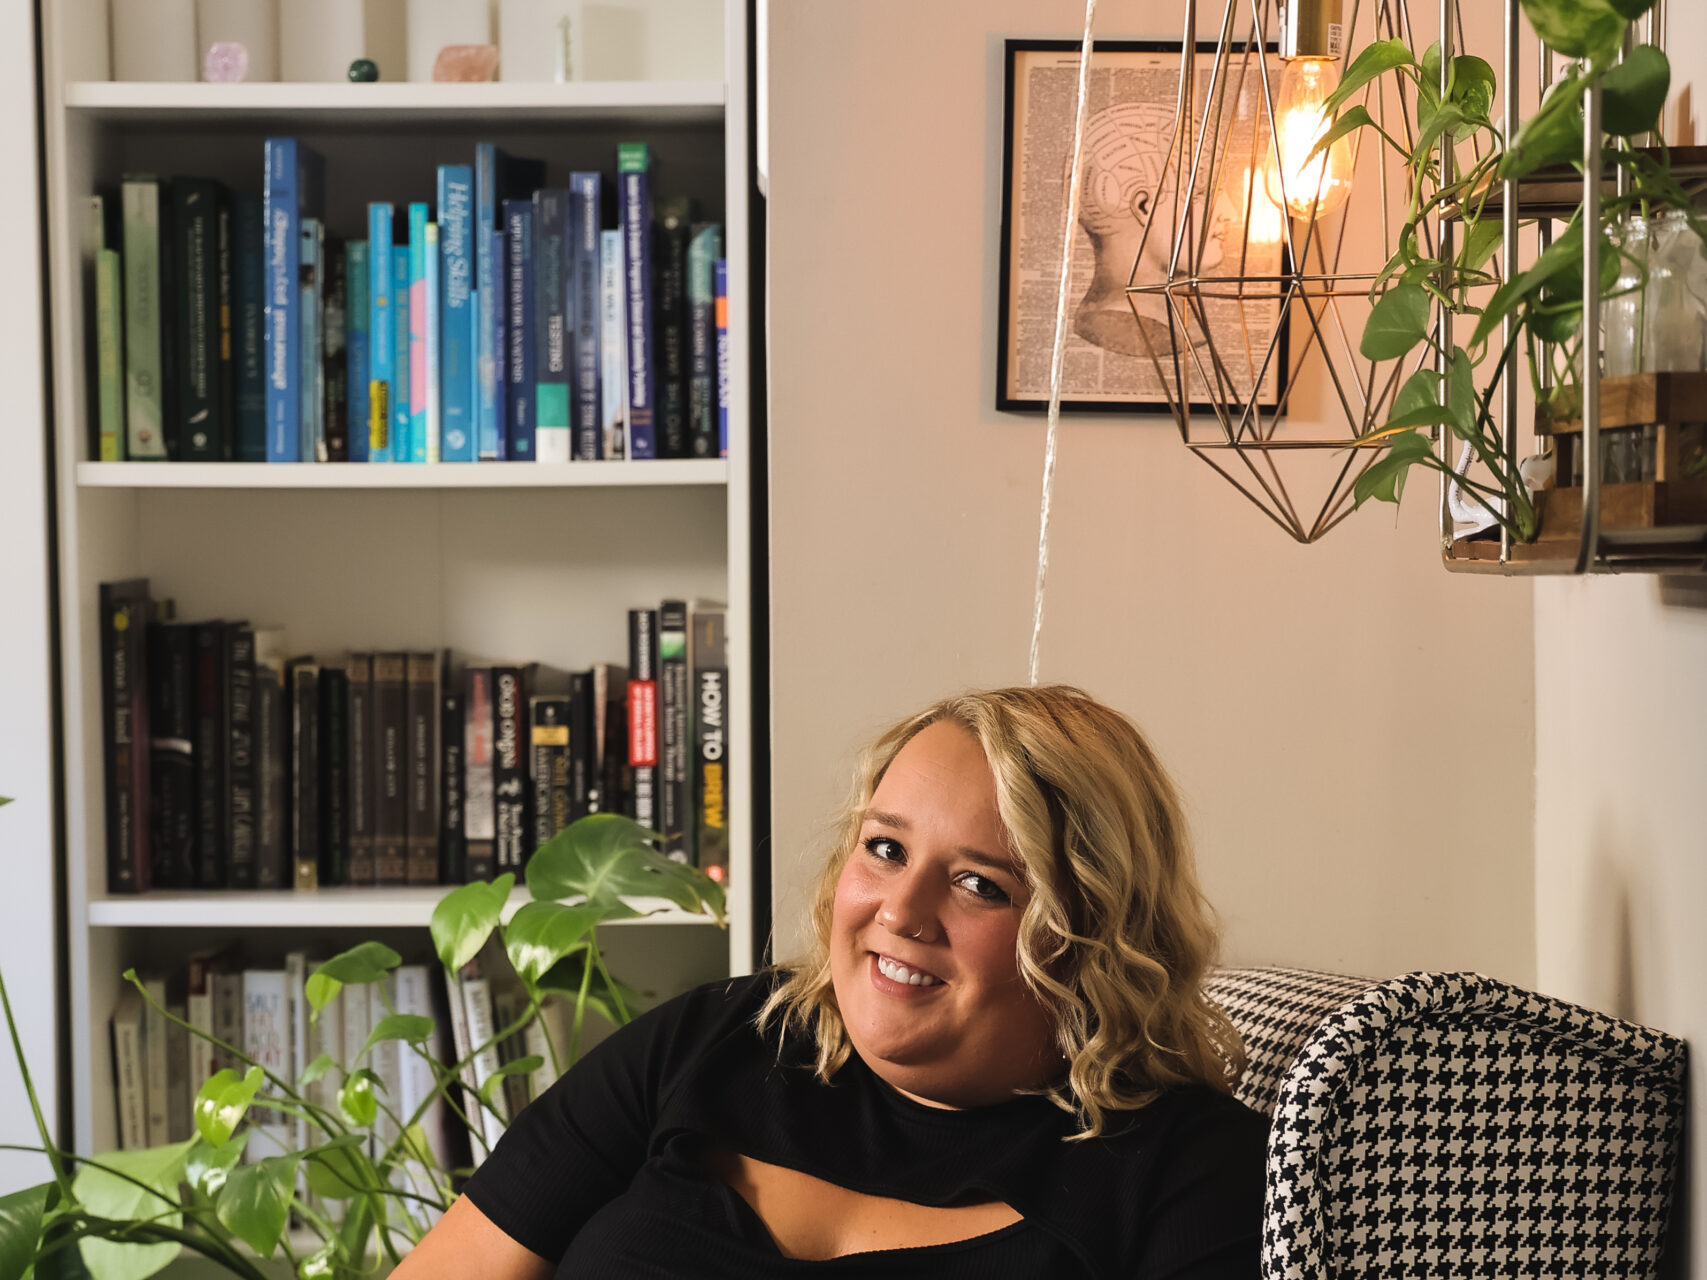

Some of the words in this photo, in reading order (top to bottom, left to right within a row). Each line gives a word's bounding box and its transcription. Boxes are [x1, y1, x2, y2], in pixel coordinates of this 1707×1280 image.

[442, 182, 469, 256] Helping
[510, 213, 523, 265] APPLIED
[272, 208, 290, 305] psychology
[606, 239, 614, 265] INTO
[606, 268, 614, 288] THE
[448, 255, 469, 308] Skills
[510, 267, 523, 327] BEHAVIOR
[271, 309, 287, 389] abnormal
[548, 315, 564, 373] TESTING
[498, 674, 514, 718] GOOD
[702, 671, 722, 727] HOW
[115, 707, 131, 744] food
[495, 718, 517, 769] OMENS
[703, 728, 723, 761] TO
[537, 747, 550, 816] AMERICAN
[704, 762, 723, 829] BREW
